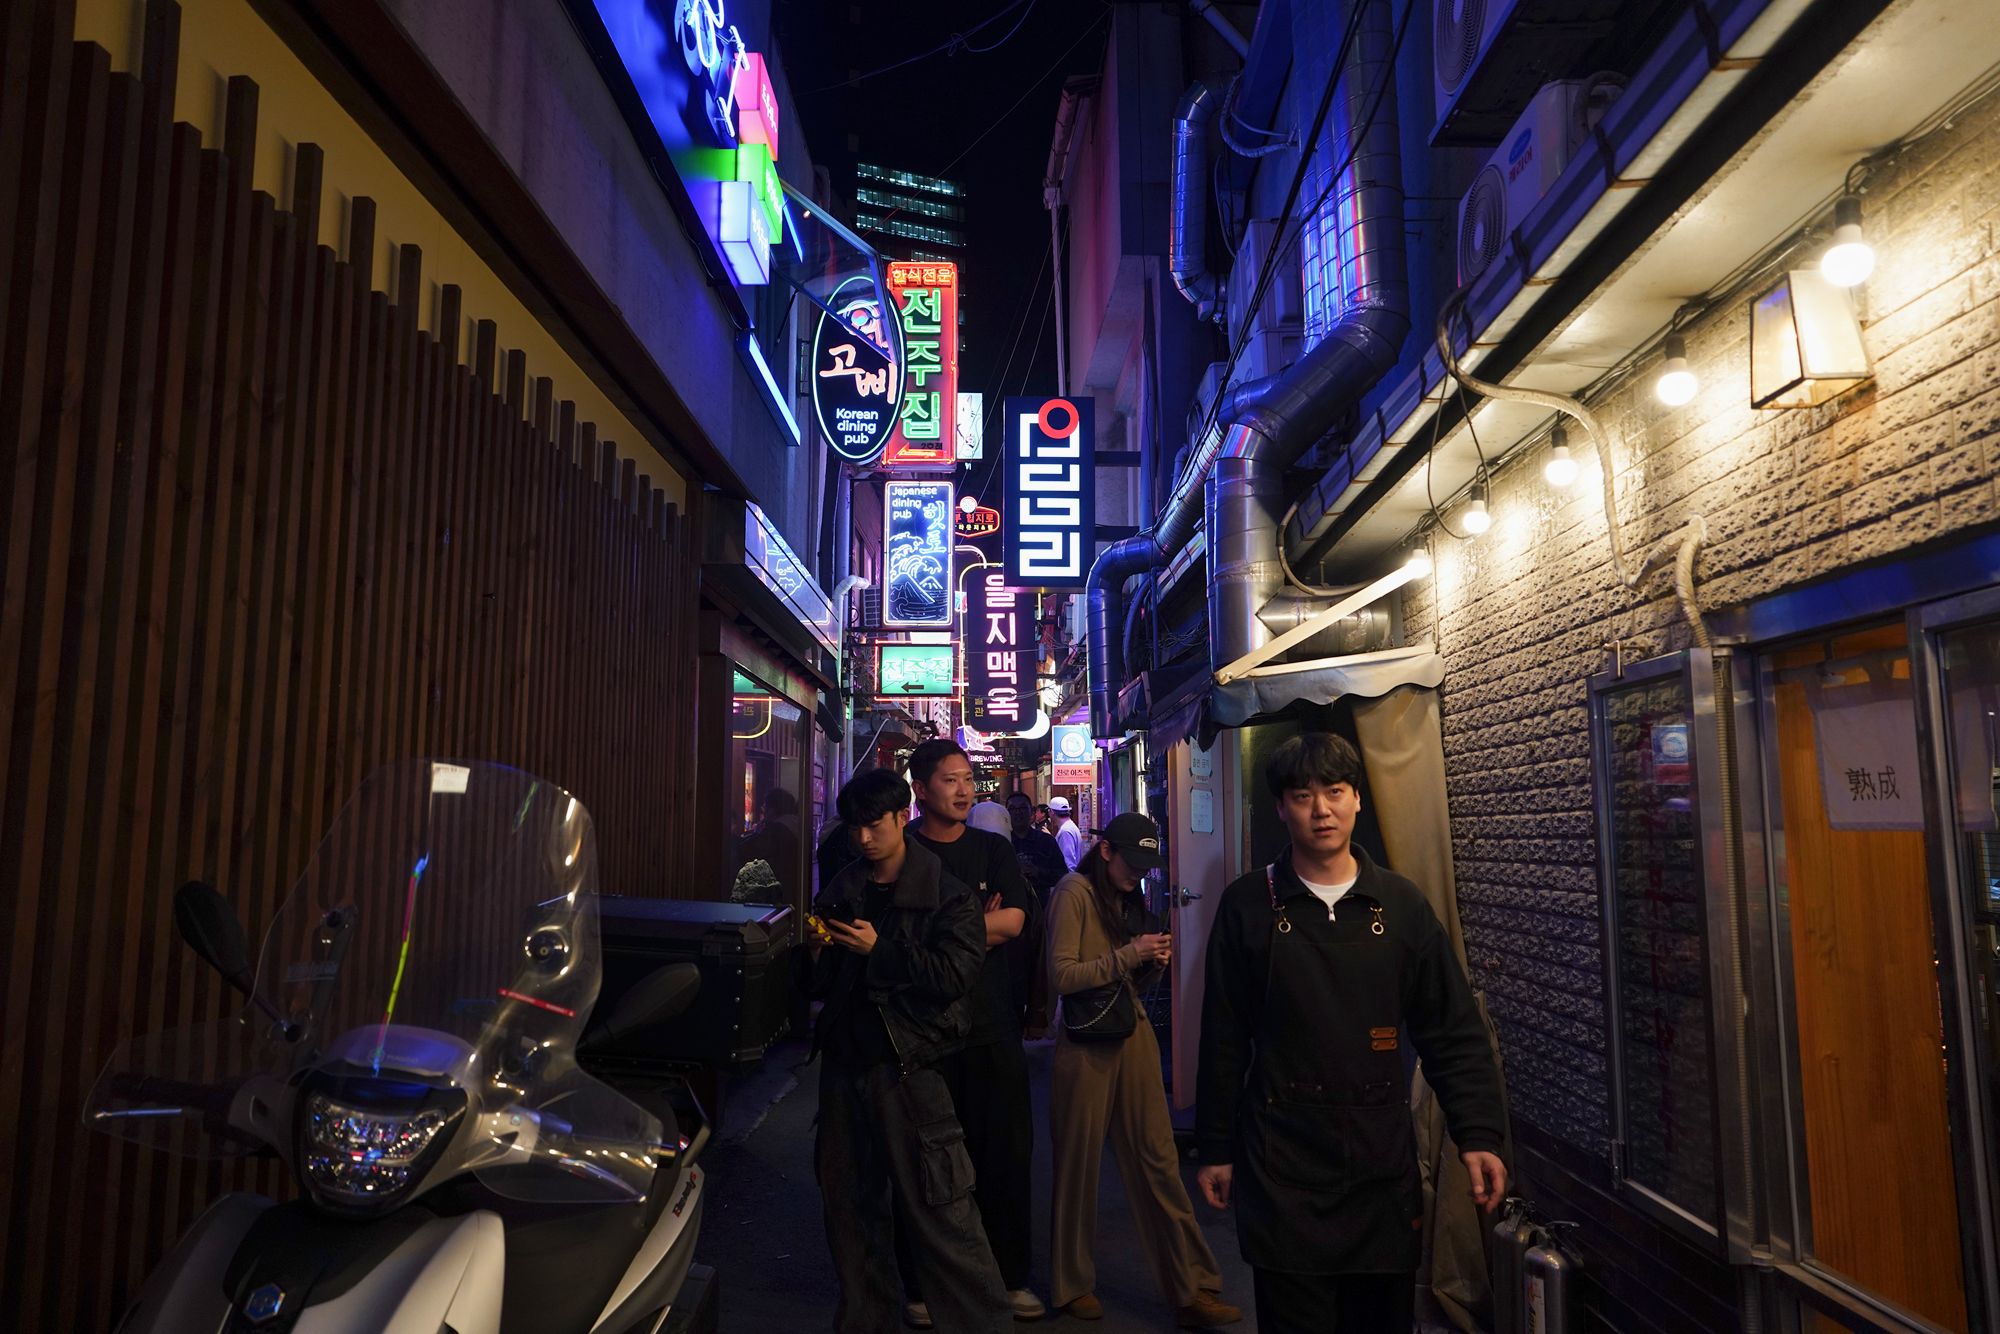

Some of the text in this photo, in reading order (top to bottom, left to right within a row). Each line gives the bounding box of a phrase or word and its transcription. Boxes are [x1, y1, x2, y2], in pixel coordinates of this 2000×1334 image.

[892, 267, 952, 283] 한식전문
[901, 288, 942, 439] 전주집
[819, 343, 898, 405] 고삐
[836, 408, 879, 421] Korean
[837, 420, 877, 435] dining
[844, 433, 870, 446] pub
[891, 487, 938, 498] Japanese
[892, 497, 922, 510] dining
[893, 509, 913, 521] pub
[985, 574, 1020, 722] 을지맥옥
[884, 656, 953, 682] 전주집
[1845, 766, 1900, 802] 熟成
